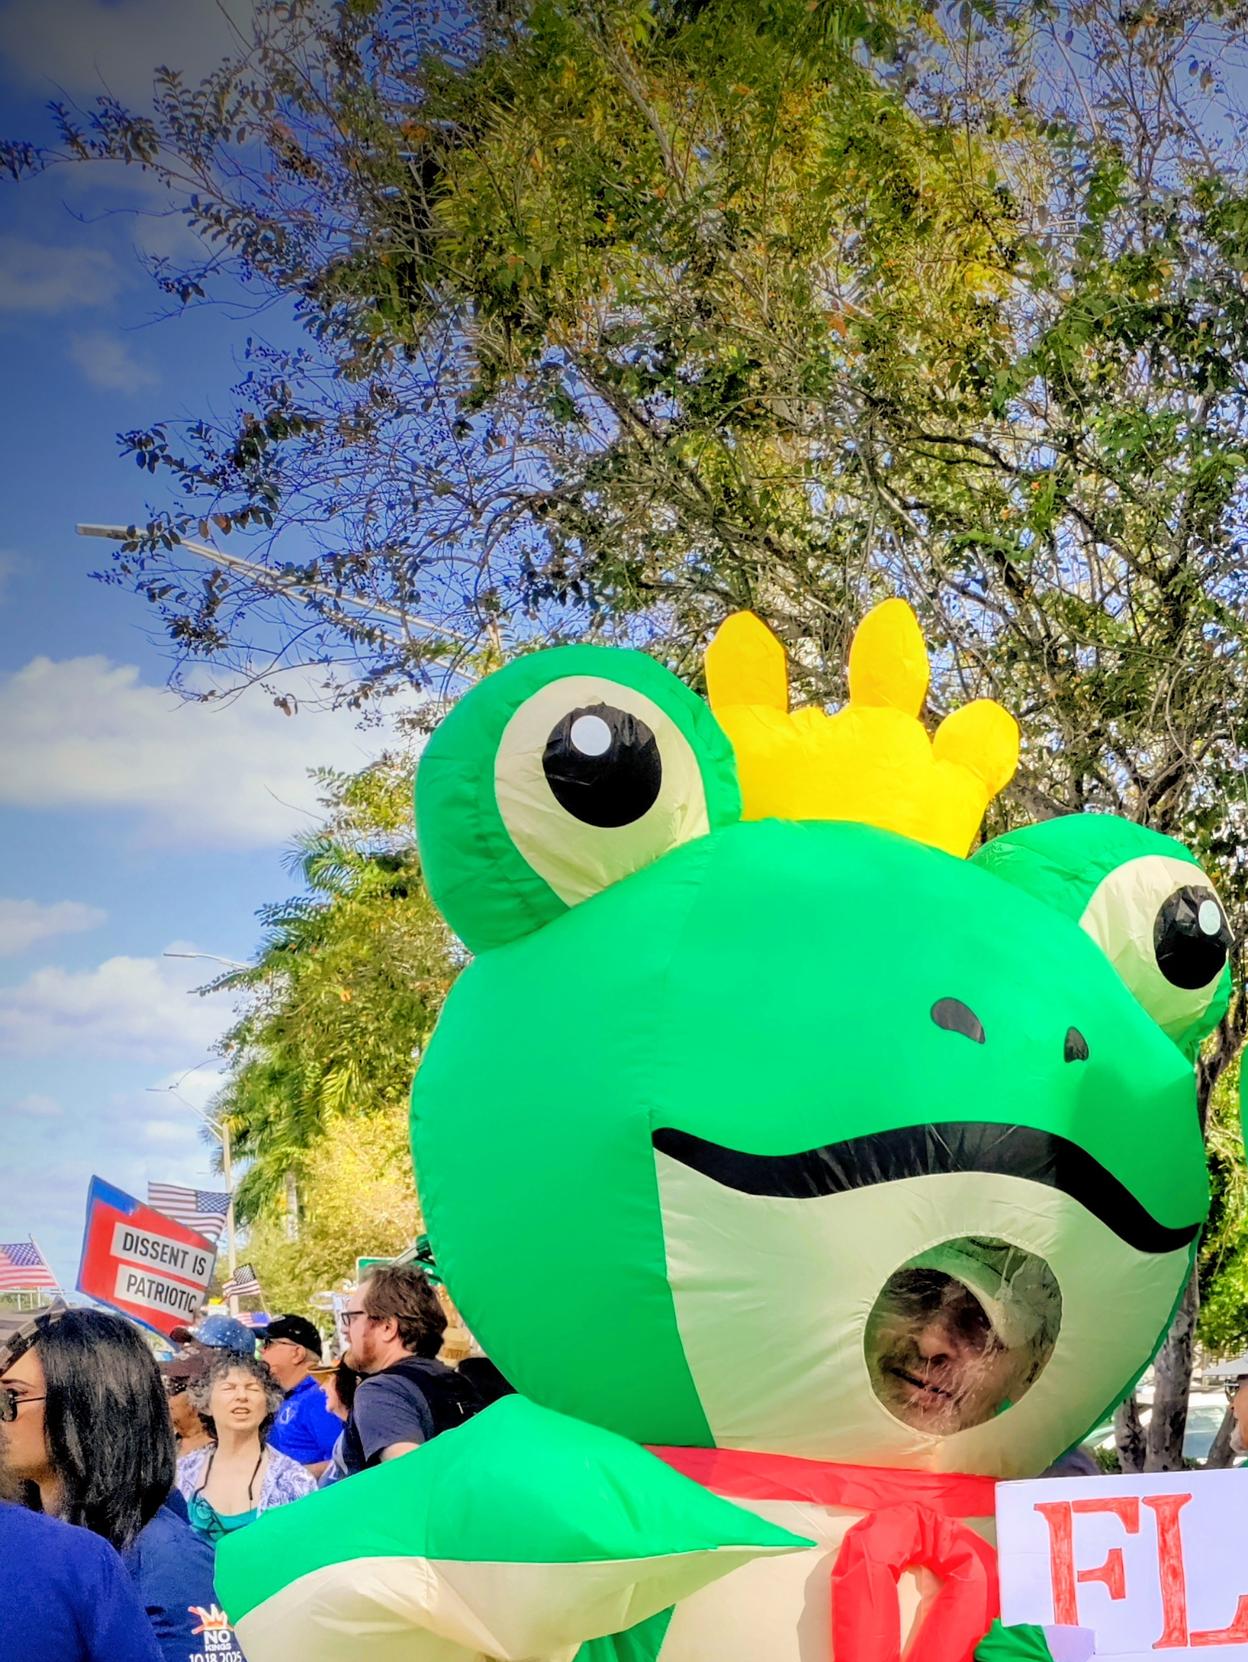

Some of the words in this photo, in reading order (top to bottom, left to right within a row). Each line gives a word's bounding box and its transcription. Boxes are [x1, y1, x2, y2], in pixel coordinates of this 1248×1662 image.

[122, 1232, 188, 1269] DISSENT
[192, 1255, 206, 1276] IS
[126, 1274, 197, 1313] PATRIOTIC
[204, 1630, 230, 1644] NO
[205, 1643, 231, 1651] KINGS
